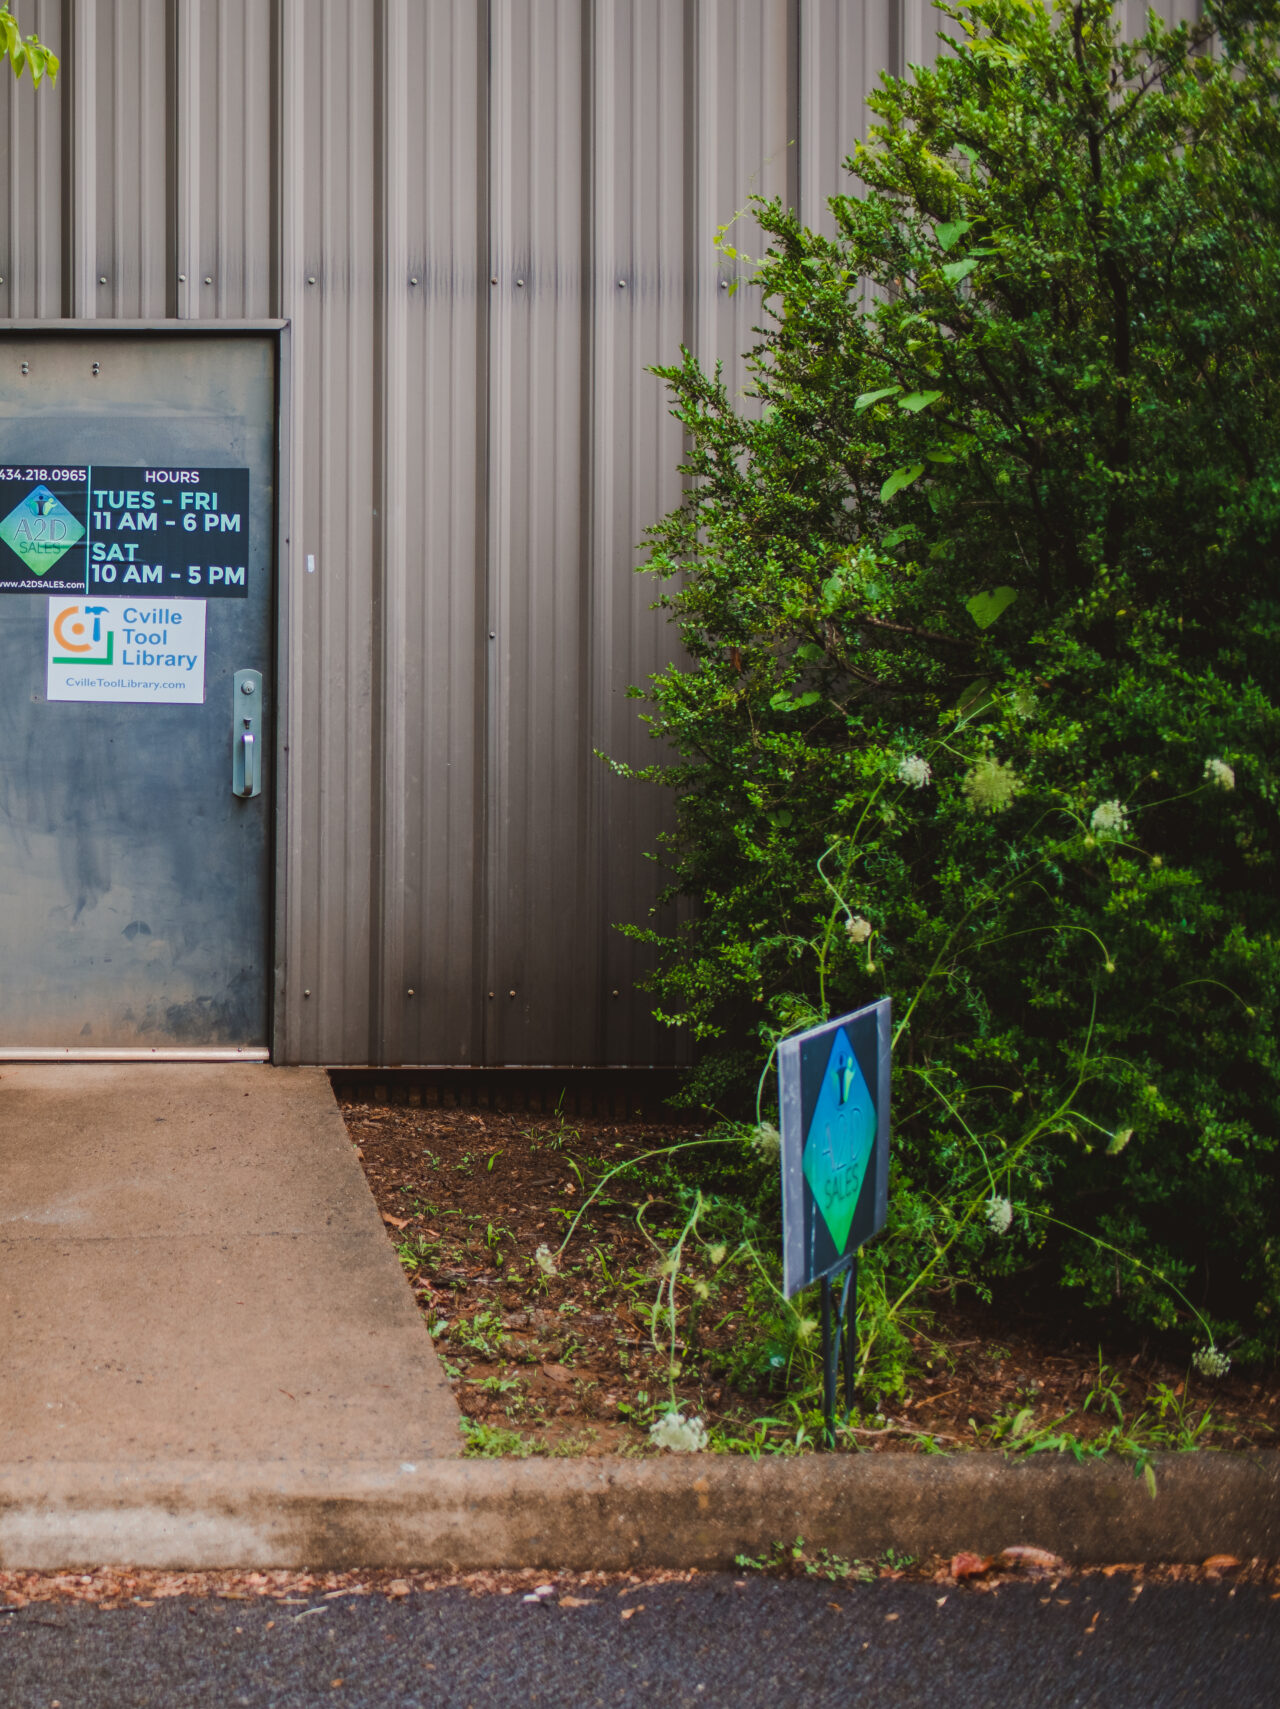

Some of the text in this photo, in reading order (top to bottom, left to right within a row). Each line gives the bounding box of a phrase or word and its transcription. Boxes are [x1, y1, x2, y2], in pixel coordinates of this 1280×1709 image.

[145, 470, 200, 484] HOURS
[93, 490, 156, 510] TUES
[180, 492, 219, 511] FRI
[13, 518, 68, 542] A2D
[93, 511, 112, 530] 11
[117, 511, 158, 531] AM
[183, 513, 198, 532] 6
[204, 514, 241, 533] PM
[19, 541, 62, 555] SALES
[91, 542, 140, 562] SAT
[91, 564, 118, 584] 10
[122, 565, 163, 584] AM
[188, 566, 202, 585] 5
[208, 566, 246, 586] PM
[122, 607, 183, 625] Cville
[122, 628, 168, 646] Tool
[121, 649, 198, 672] Library
[65, 677, 187, 692] CvilleToolLibrary.com
[824, 1163, 860, 1210] SALES
